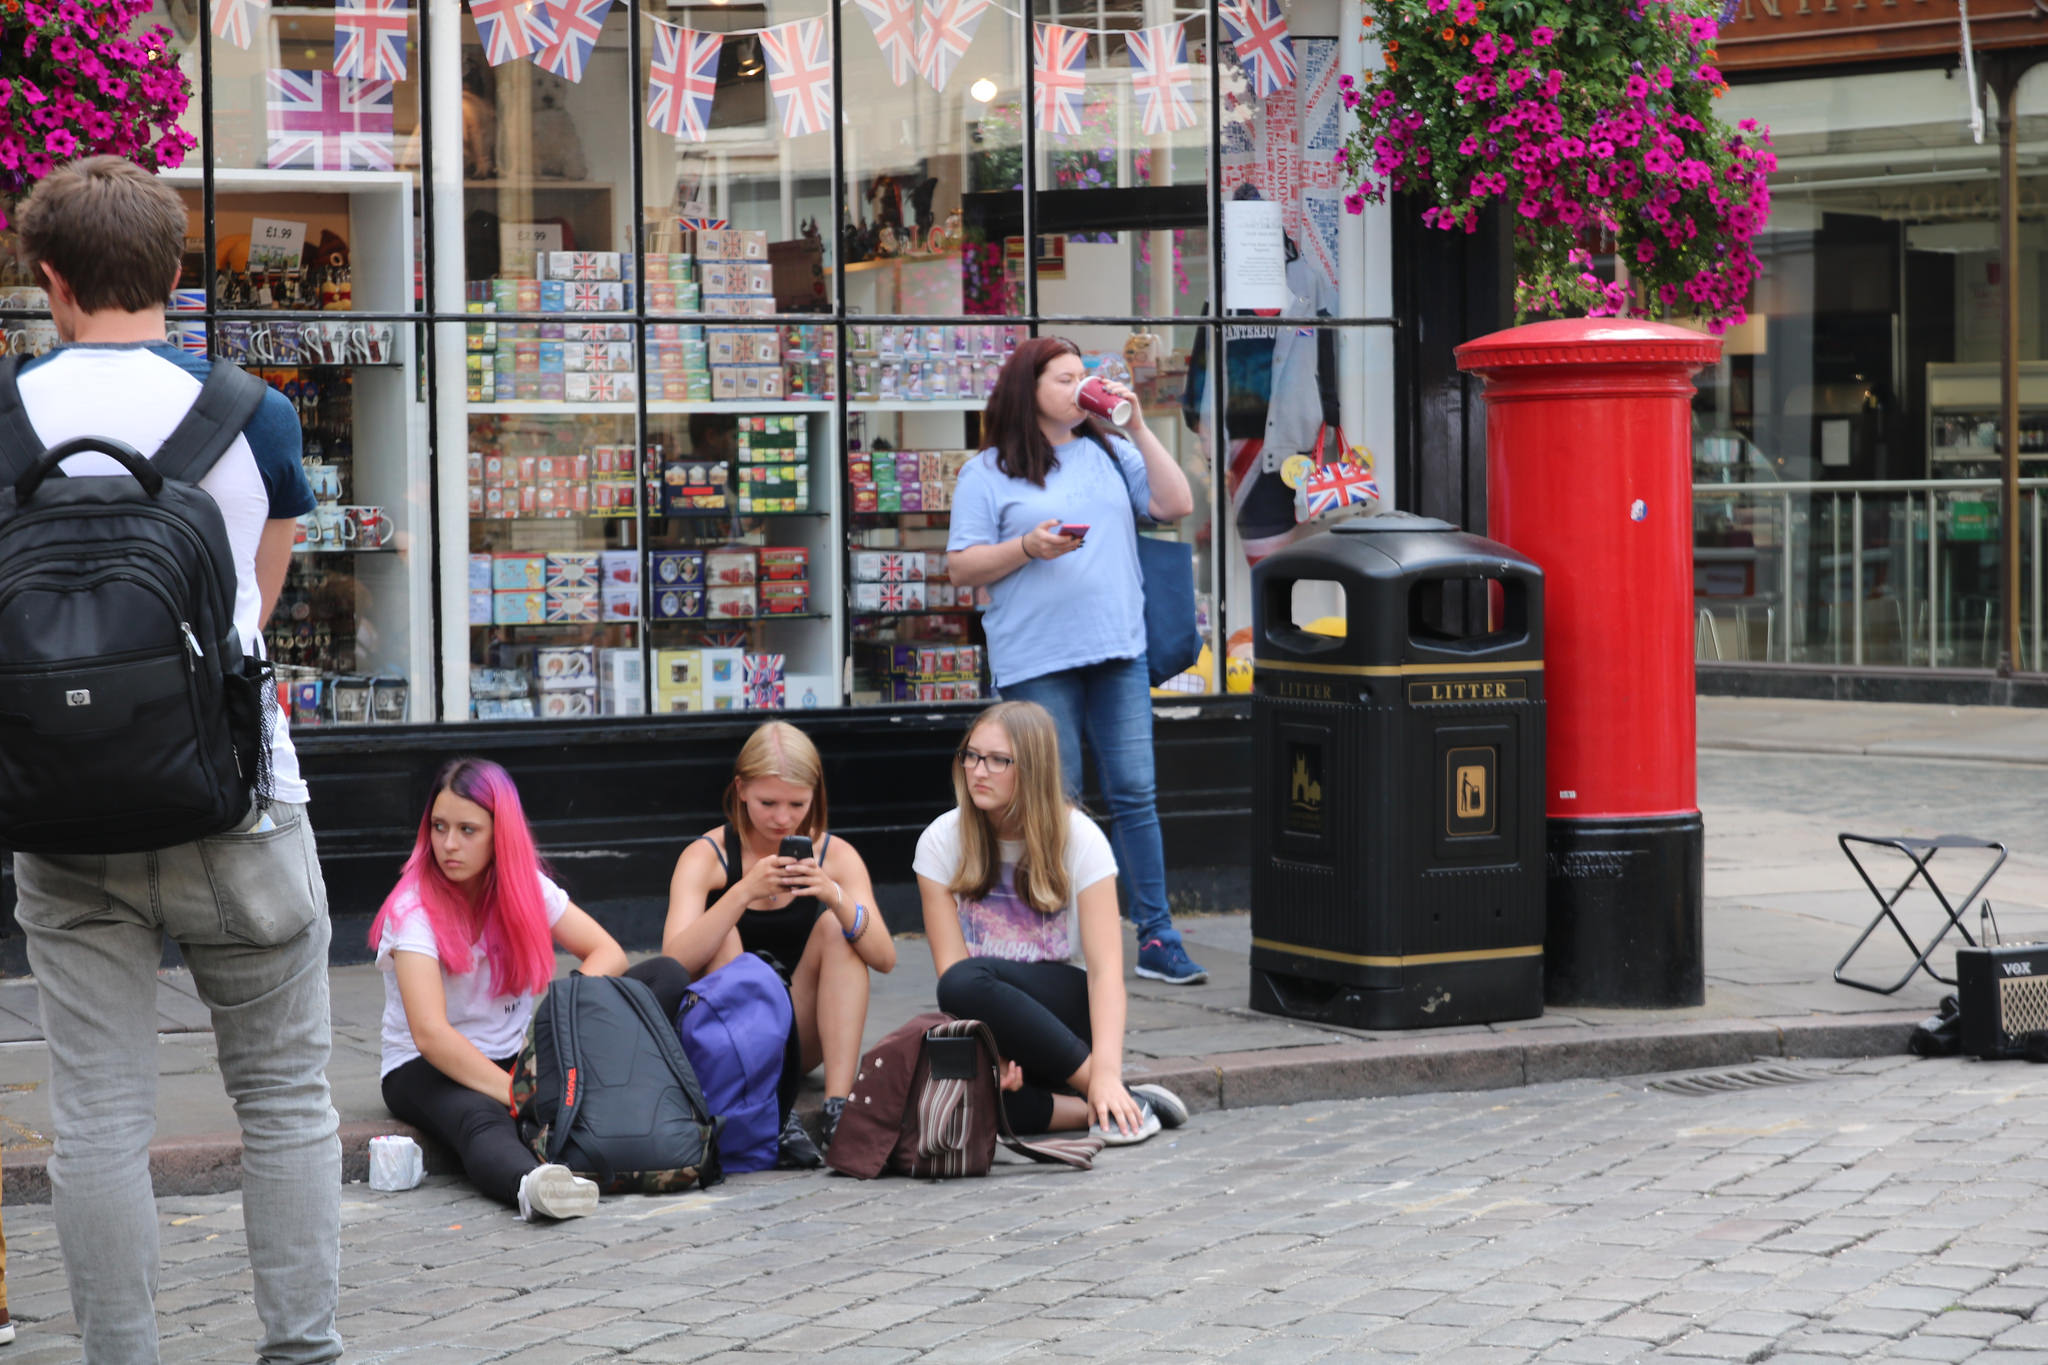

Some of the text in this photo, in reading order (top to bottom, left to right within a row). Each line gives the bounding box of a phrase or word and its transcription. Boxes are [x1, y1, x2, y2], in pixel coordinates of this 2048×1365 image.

[1277, 147, 1290, 206] LONDON
[266, 226, 292, 239] £1.99
[1280, 682, 1332, 700] LITTER
[1431, 682, 1508, 700] LITTER
[982, 931, 1040, 962] happy
[2002, 962, 2032, 976] VOX
[565, 1067, 577, 1107] DAKINE
